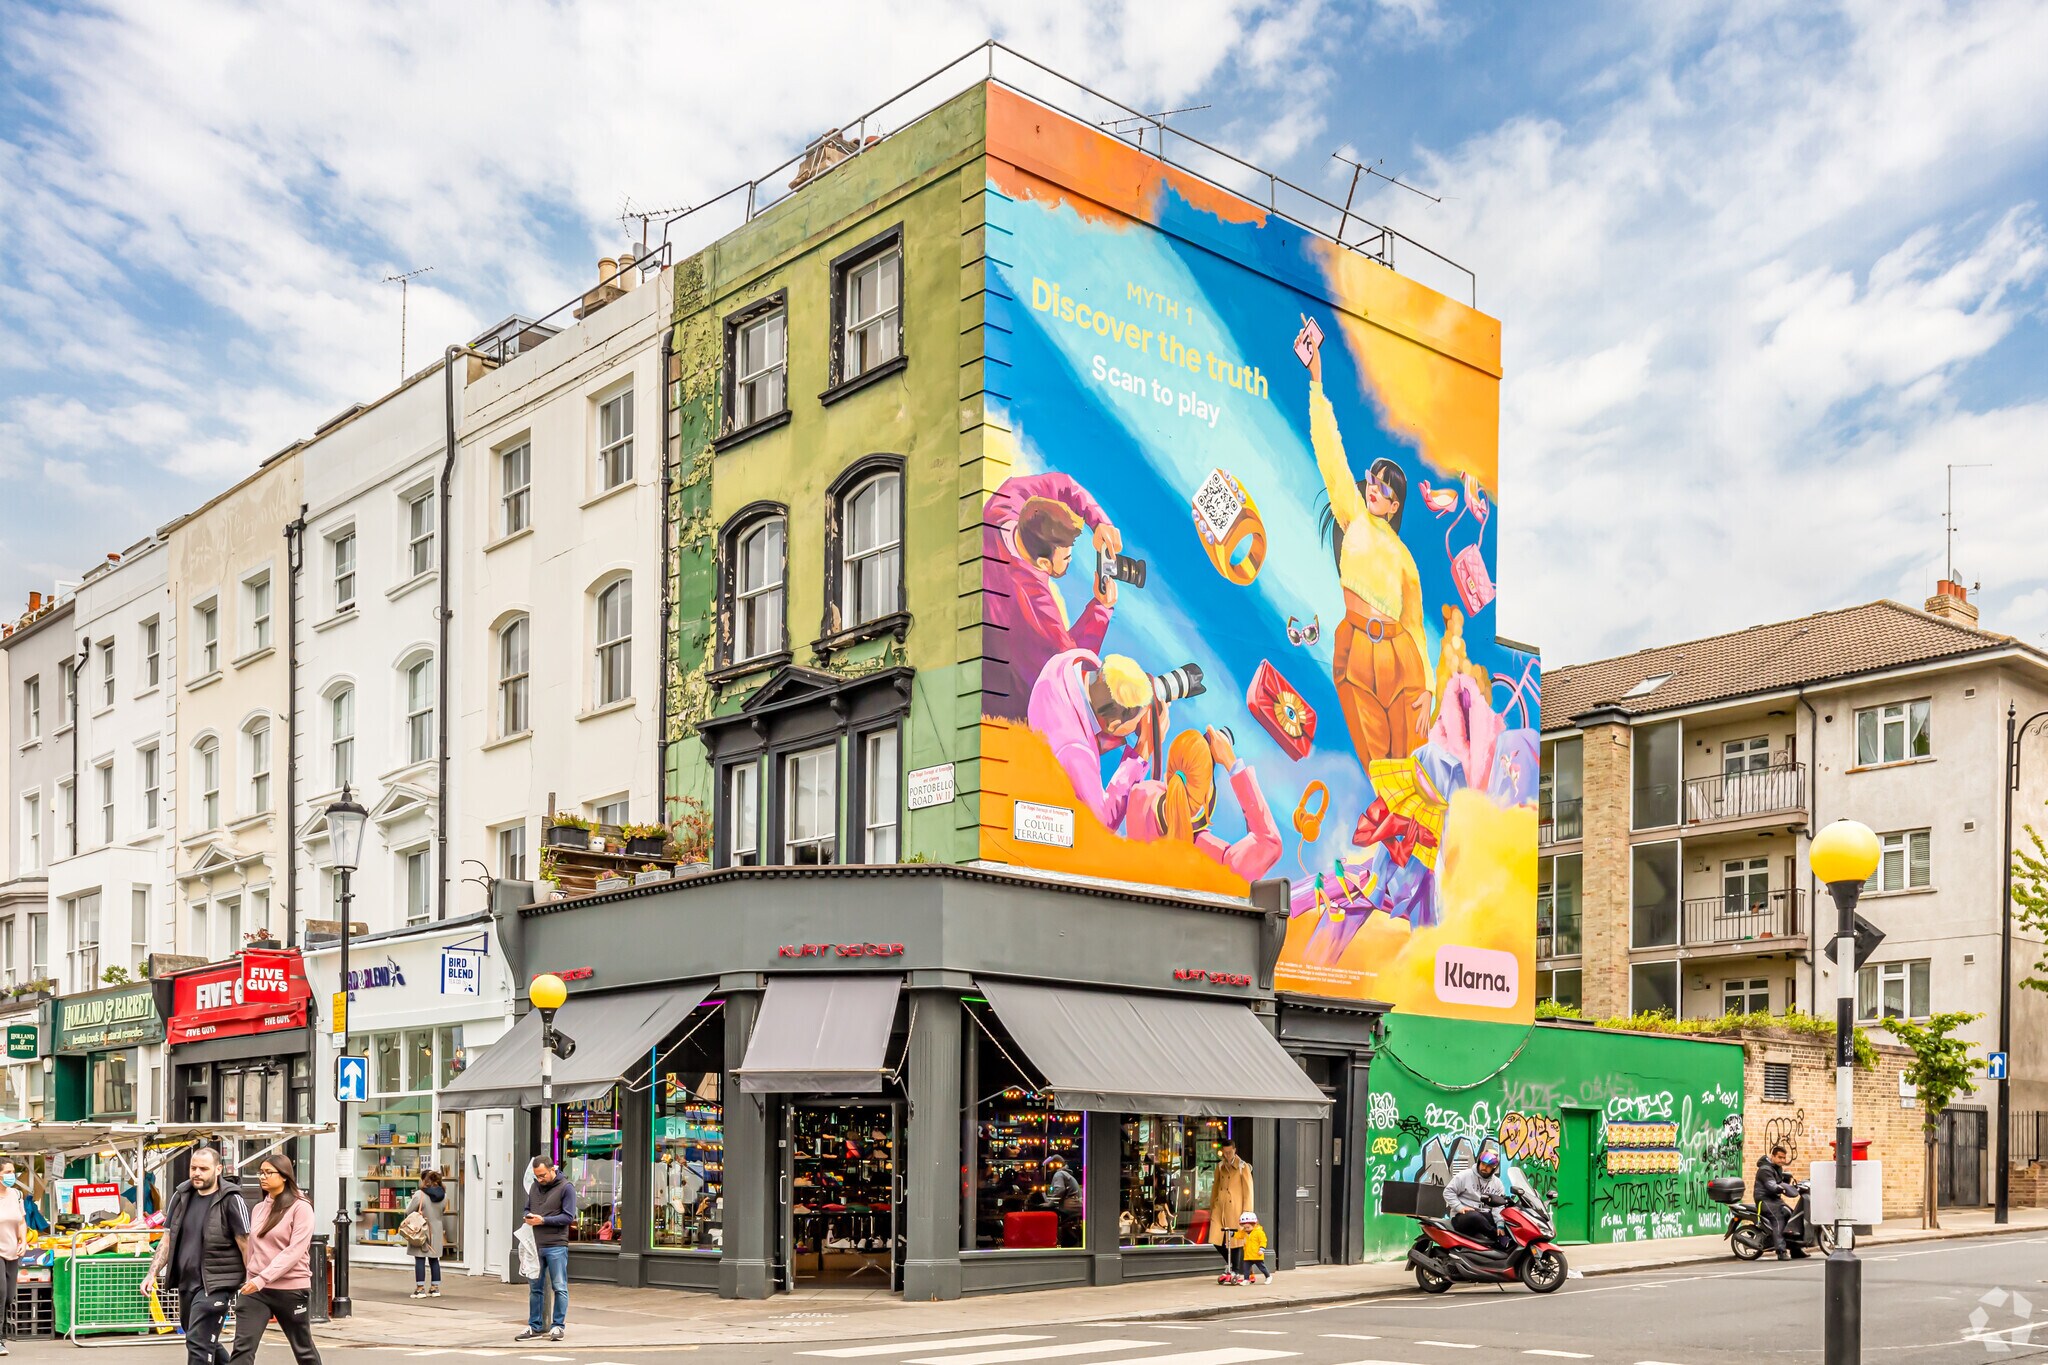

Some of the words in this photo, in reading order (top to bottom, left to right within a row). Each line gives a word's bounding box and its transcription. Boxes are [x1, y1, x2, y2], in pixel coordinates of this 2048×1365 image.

[1127, 281, 1179, 319] MYTH
[1185, 307, 1194, 326] 1
[1032, 276, 1153, 353] Discover
[1158, 331, 1201, 373] the
[1207, 352, 1269, 400] truth
[1092, 354, 1146, 397] Scan
[1151, 377, 1174, 407] to
[1178, 392, 1220, 429] play
[909, 779, 954, 796] PORTOBELLO
[912, 794, 933, 806] ROAD
[1024, 818, 1065, 833] COLVILLE
[1017, 828, 1055, 843] TERRACE
[778, 943, 829, 957] KURT
[834, 943, 905, 957] GEIGER
[448, 957, 467, 968] BIRD
[250, 967, 284, 980] FIVE
[448, 968, 473, 979] BLEND
[1174, 968, 1206, 981] KURT
[1210, 972, 1253, 986] GEIGER
[1444, 961, 1511, 993] Klarna.
[246, 980, 289, 992] GUYS
[196, 981, 233, 1010] FIVE
[63, 1000, 104, 1031] HOLLAND
[103, 998, 115, 1025] &
[115, 992, 156, 1019] BARRETT
[264, 1016, 276, 1026] FIVE
[276, 1014, 290, 1024] GUYS
[10, 1033, 36, 1041] HOLLAND
[185, 1028, 201, 1037] FIVE
[201, 1025, 216, 1034] GUYS
[1612, 1227, 1628, 1243] NOT
